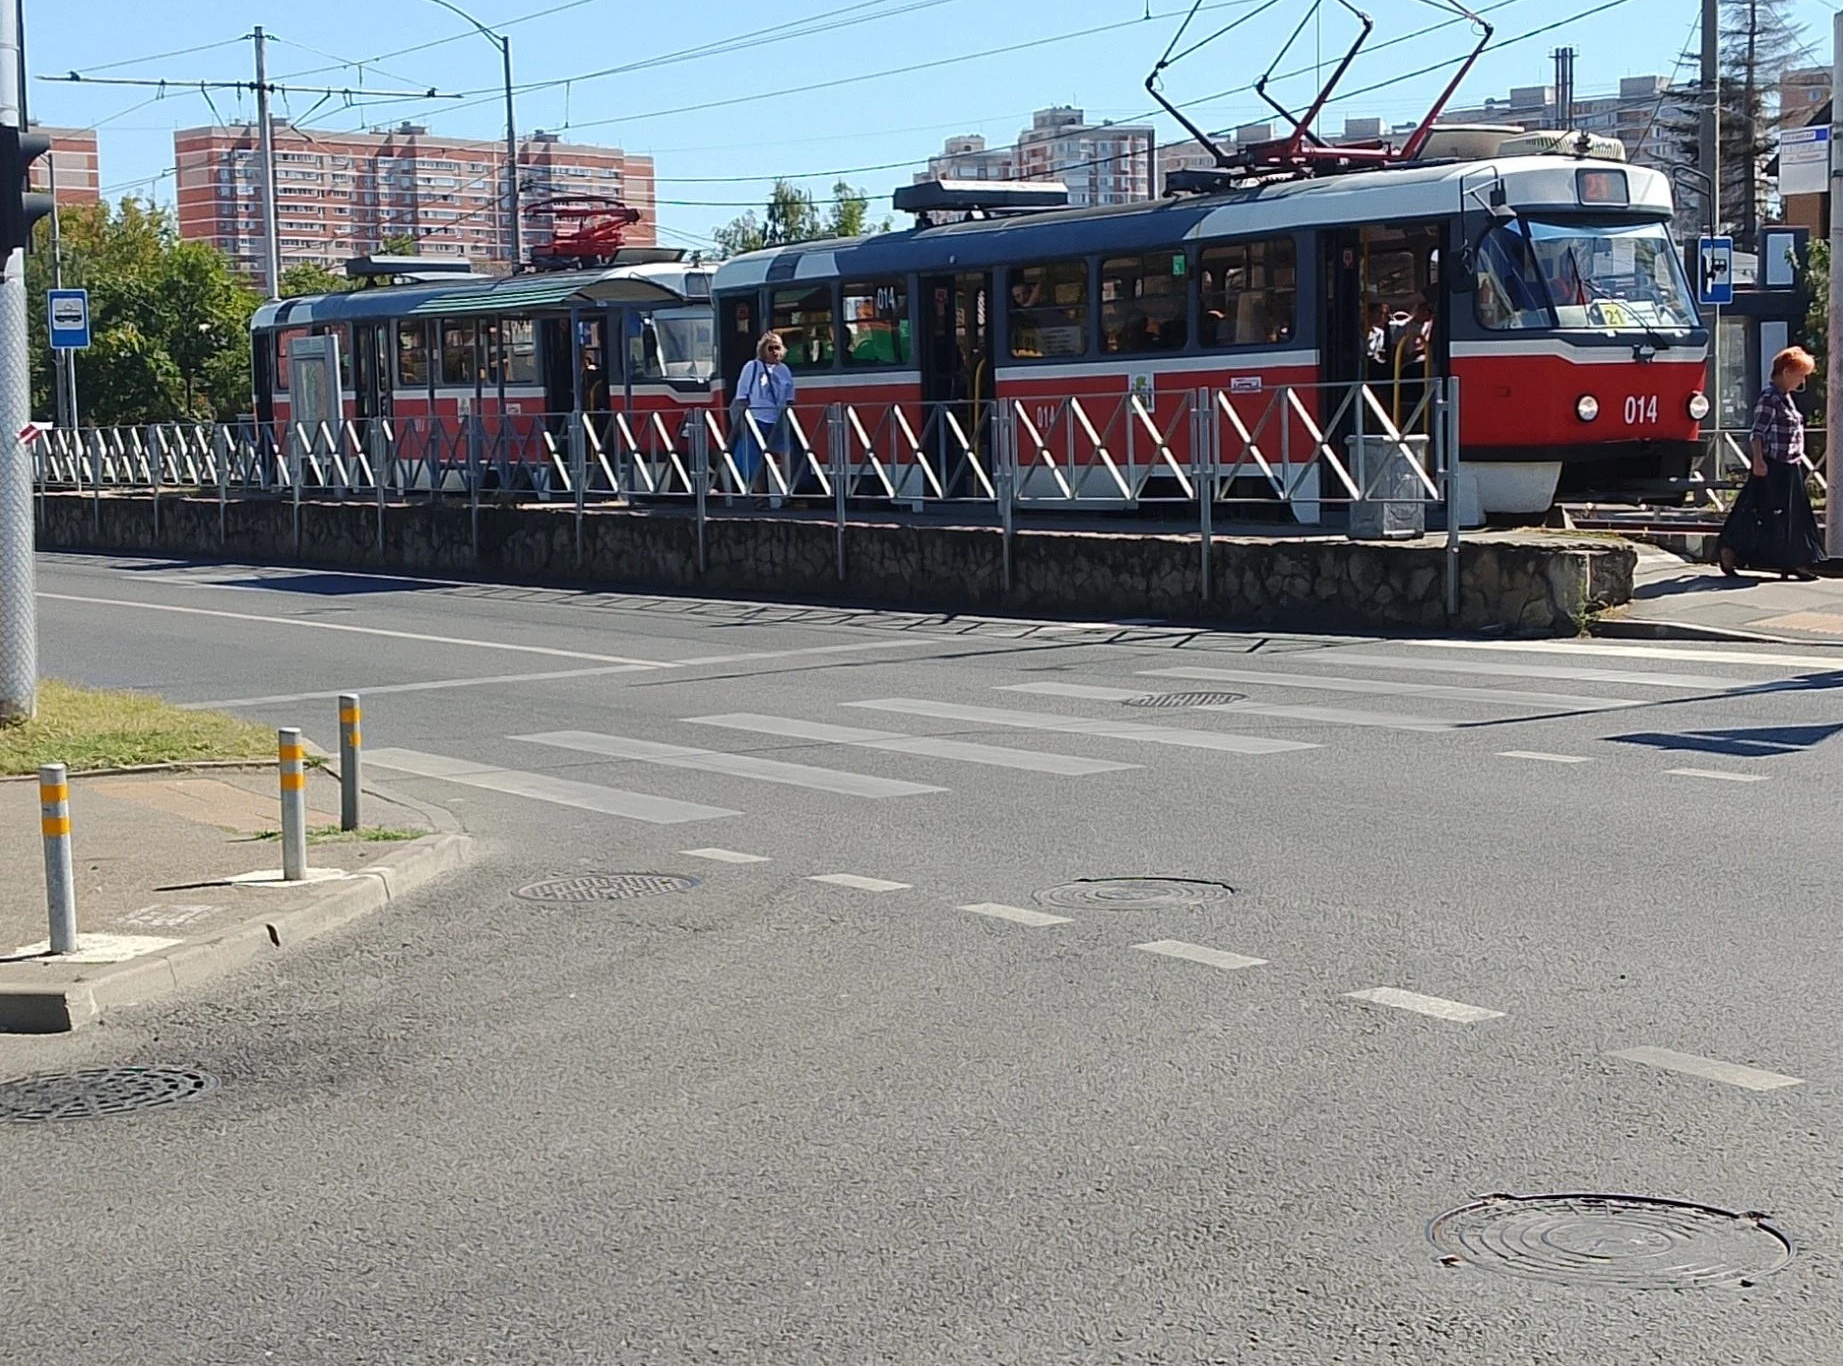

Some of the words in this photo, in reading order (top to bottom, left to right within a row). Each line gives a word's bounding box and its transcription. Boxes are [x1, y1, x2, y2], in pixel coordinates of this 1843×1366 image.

[1585, 174, 1609, 198] 21
[877, 286, 897, 310] 014
[1605, 309, 1624, 325] 21
[1036, 406, 1056, 428] 014
[1624, 395, 1658, 424] 014
